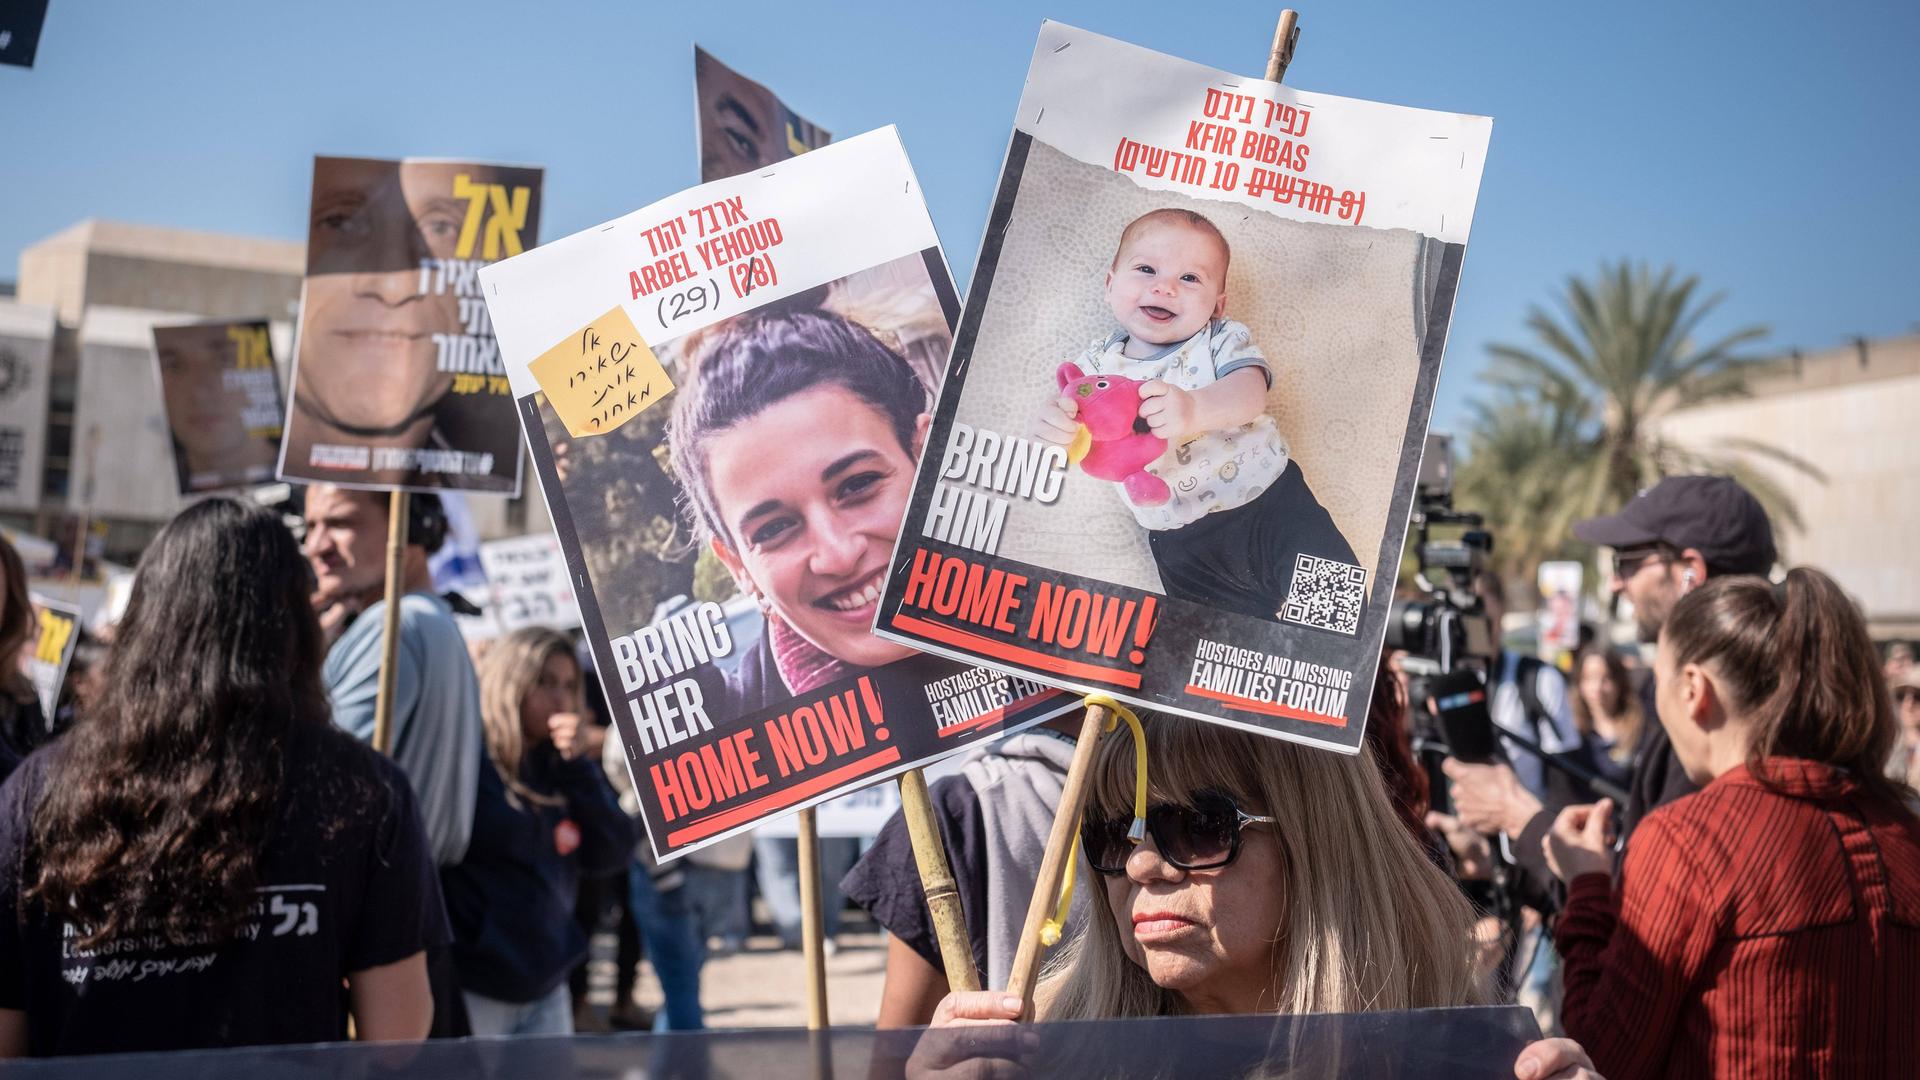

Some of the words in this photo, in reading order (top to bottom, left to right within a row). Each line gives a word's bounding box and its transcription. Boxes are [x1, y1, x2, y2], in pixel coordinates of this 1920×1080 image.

[1203, 87, 1256, 124] ביבס
[1263, 99, 1311, 137] כפיר
[1185, 120, 1237, 155] KFIR
[1240, 130, 1310, 172] BIBAS
[1209, 161, 1240, 191] 10
[453, 174, 531, 260] אל
[640, 216, 687, 257] יהוד
[688, 196, 748, 238] ארבל
[629, 251, 698, 300] ARBEL
[695, 217, 783, 270] YEHOUD
[728, 253, 778, 299] (28)
[657, 278, 720, 328] (29)
[582, 327, 601, 356] אל
[590, 383, 650, 429] מאחור
[939, 422, 1068, 503] BRING
[921, 484, 1008, 556] HIM
[904, 547, 1028, 633] HOME
[1028, 581, 1160, 664] NOW!
[610, 601, 732, 694] BRING
[1196, 638, 1264, 672] HOSTAGES
[1263, 654, 1292, 678] AND
[1291, 660, 1352, 690] MISSING
[924, 666, 988, 703] HOSTAGES
[931, 677, 1014, 730] FAMILIES
[1189, 659, 1276, 704] FAMILIES
[1277, 678, 1348, 720] FORUM
[628, 678, 714, 755] HER
[650, 727, 769, 823] HOME
[764, 675, 890, 778] NOW!
[271, 894, 319, 936] גל
